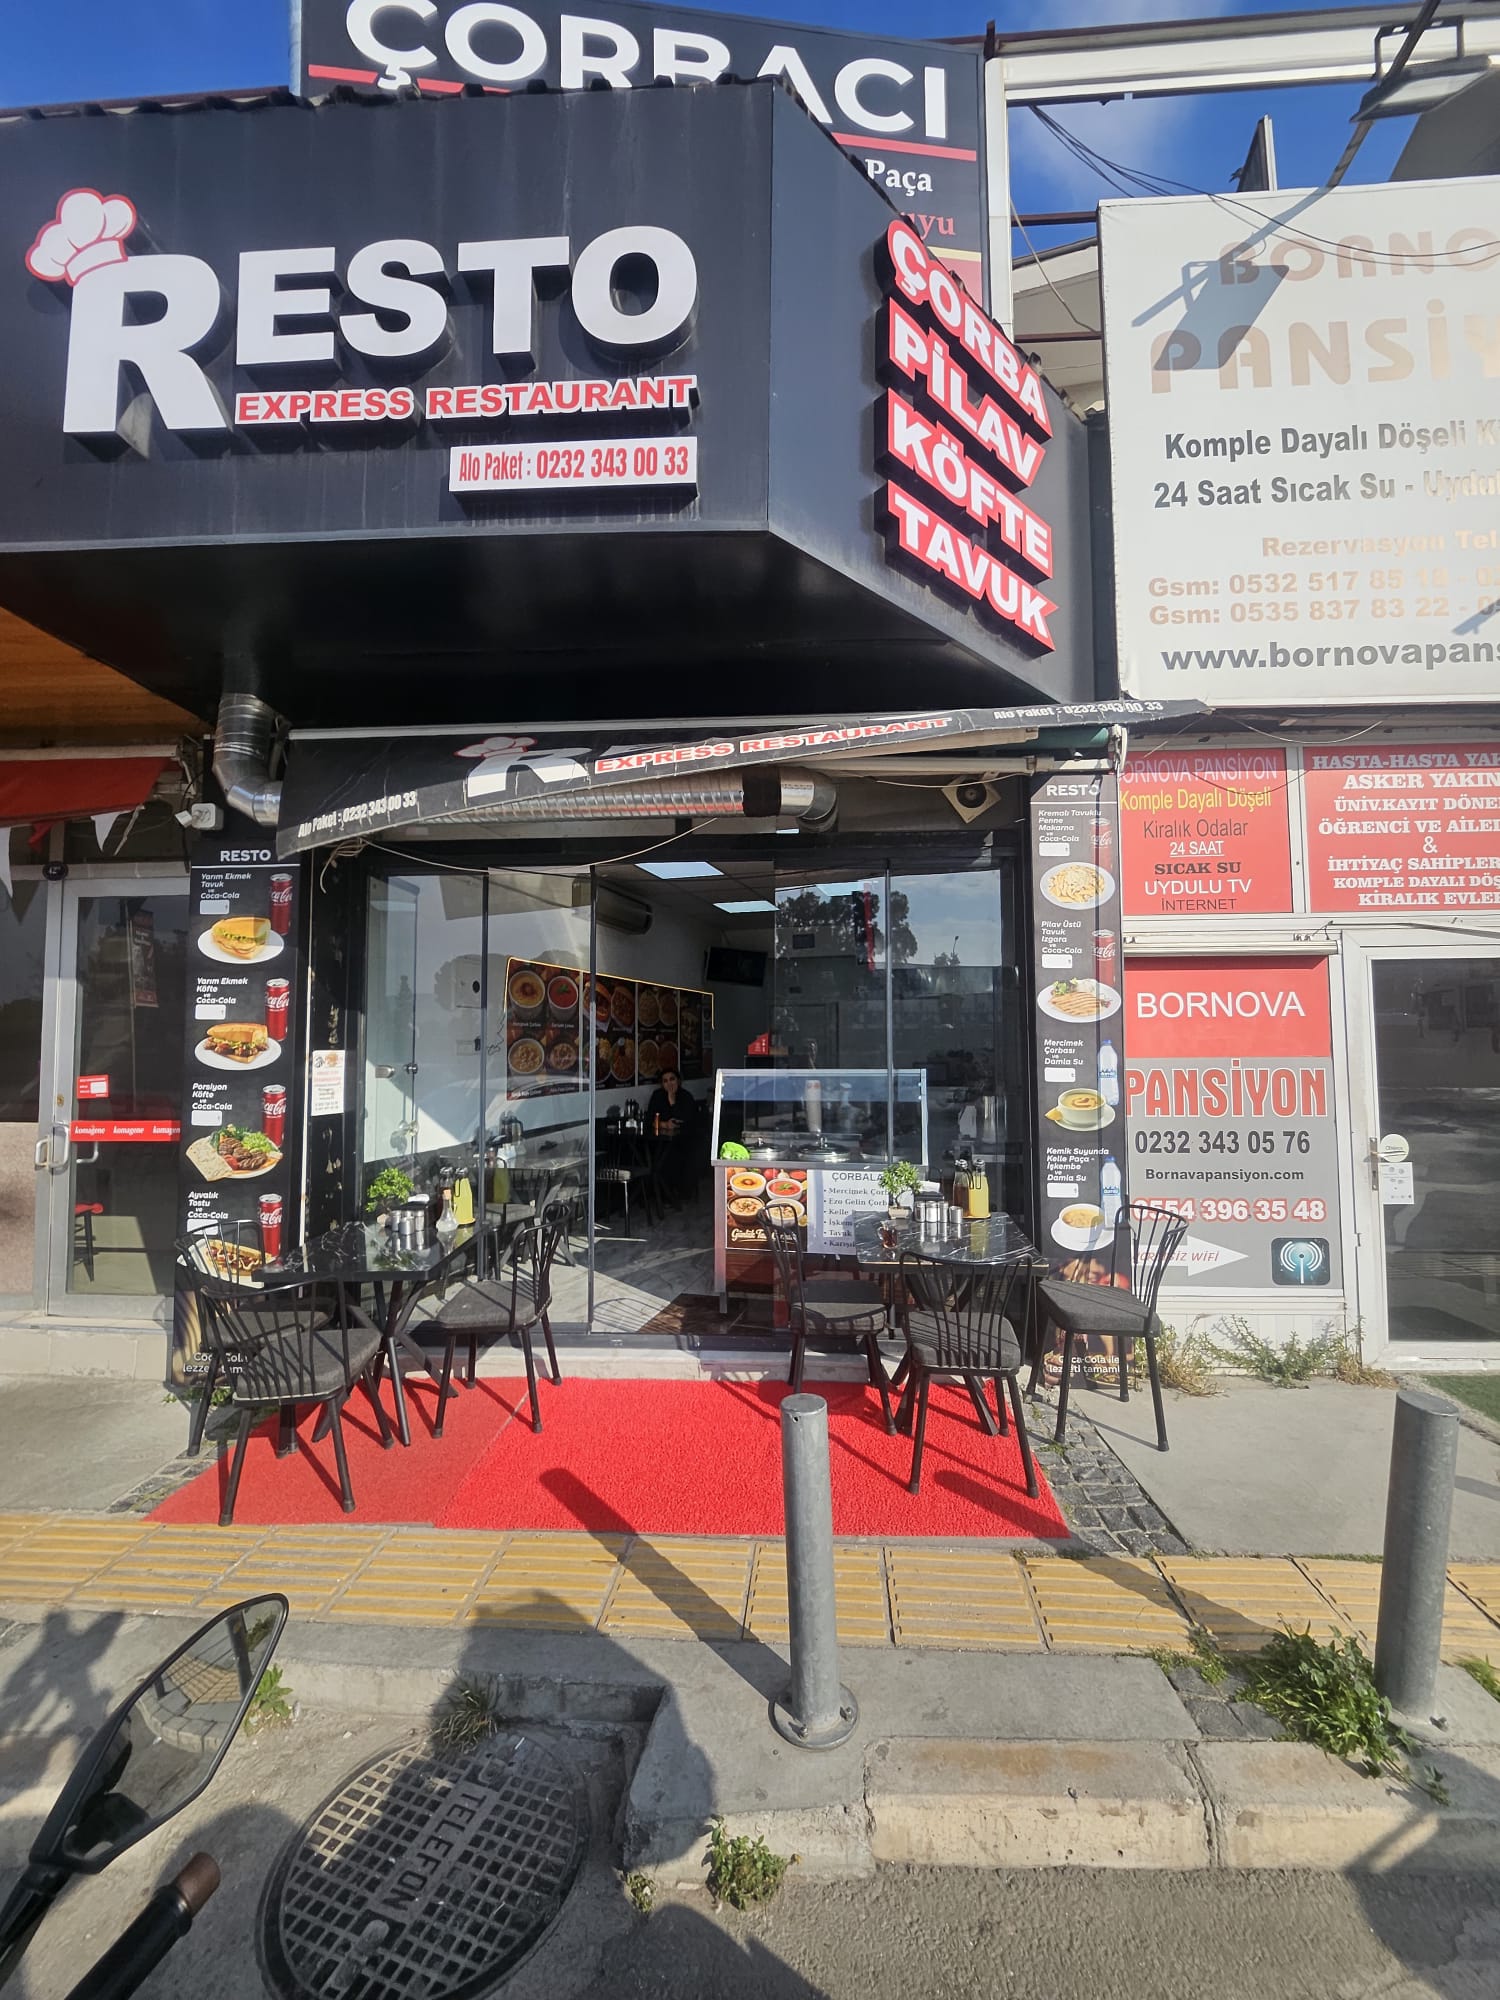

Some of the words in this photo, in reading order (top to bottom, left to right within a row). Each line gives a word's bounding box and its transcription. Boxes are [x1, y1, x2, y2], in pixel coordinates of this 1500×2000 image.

[346, 0, 948, 139] ÇORBACI
[864, 158, 933, 195] Paça
[62, 225, 697, 432] RESTO
[890, 225, 1048, 420] ÇORBA
[236, 388, 413, 424] EXPRESS
[427, 376, 697, 416] RESTAURANT
[892, 321, 1039, 483] PİLAV
[1165, 429, 1271, 462] Komple
[1281, 423, 1368, 459] Dayalı
[1378, 419, 1465, 455] Döşeli
[459, 452, 480, 483] Alo
[483, 451, 523, 482] Paket
[536, 447, 586, 480] 0232
[590, 447, 627, 479] 343
[633, 446, 659, 477] 00
[663, 445, 689, 476] 33
[892, 402, 1050, 568] KÖFTE
[1154, 483, 1188, 508] 24
[1197, 477, 1261, 505] Saat
[1270, 474, 1351, 503] Sıcak
[1360, 472, 1395, 498] Su
[1262, 531, 1445, 557] Rezervasyon
[893, 496, 1052, 639] TAVUK
[1148, 576, 1219, 597] Gsm:
[1229, 571, 1298, 594] 0532
[1307, 570, 1358, 592] 517
[1369, 569, 1405, 590] 85
[1149, 605, 1220, 625] Gsm:
[1230, 601, 1299, 623] 0535
[1308, 600, 1360, 622] 837
[1371, 598, 1405, 620] 83
[1416, 596, 1450, 618] 22
[993, 711, 1015, 720] Alo
[1064, 704, 1097, 714] 0232
[1097, 703, 1124, 713] 343
[1124, 702, 1143, 713] 00
[1146, 701, 1164, 711] 33
[595, 743, 735, 774] EXPRESS
[740, 717, 952, 753] RESTAURANT
[1119, 758, 1193, 784] ORNOVA
[1193, 752, 1278, 782] PANSİYON
[1312, 753, 1460, 770] HASTA-HASTA
[1343, 773, 1425, 790] ASKER
[1046, 784, 1100, 797] RESTO
[1120, 788, 1173, 814] Komple
[1177, 787, 1222, 813] Dayalı
[1227, 786, 1272, 812] Döşeli
[1334, 795, 1439, 812] ÜNİV.KAYIT
[1443, 793, 1500, 810] DÖNE
[298, 821, 312, 838] Alo
[343, 803, 368, 823] 0232
[368, 797, 387, 816] 343
[387, 794, 402, 811] 00
[402, 790, 417, 808] 33
[1038, 817, 1064, 825] Penne
[1038, 824, 1075, 832] Makarna
[1143, 820, 1192, 839] Kiralık
[1196, 818, 1249, 837] Odalar
[1318, 817, 1411, 835] ÖĞRENCİ
[1414, 820, 1442, 833] VE
[1169, 841, 1186, 856] 24
[1188, 840, 1224, 855] SAAT
[1422, 836, 1438, 854] &
[220, 849, 272, 863] RESTO
[1327, 855, 1403, 873] İHTİYAÇ
[224, 872, 252, 880] Ekmek
[1154, 863, 1211, 875] SICAK
[1217, 862, 1241, 873] SU
[200, 881, 225, 889] Tavuk
[1144, 880, 1222, 896] UYDULU
[1226, 878, 1252, 894] TV
[1333, 877, 1404, 889] KOMPLE
[1408, 875, 1466, 888] DAYALI
[200, 892, 241, 900] Coca-Cola
[1161, 897, 1237, 911] İNTERNET
[1358, 889, 1440, 906] KİRALIK
[1041, 920, 1062, 928] Pilav
[1063, 919, 1081, 928] Üstü
[1041, 928, 1066, 936] Tavuk
[196, 985, 218, 993] Köfte
[220, 977, 249, 985] Ekmek
[196, 997, 237, 1005] Coca-Cola
[1136, 990, 1307, 1018] BORNOVA
[1044, 1039, 1084, 1048] Mercimek
[1044, 1057, 1072, 1066] Damla
[1074, 1057, 1084, 1066] Su
[192, 1082, 228, 1093] Porsiyon
[192, 1090, 214, 1099] Köfte
[1126, 1058, 1329, 1118] PANSİYON
[191, 1102, 233, 1111] Coca-Cola
[113, 1125, 145, 1136] komagene
[1134, 1130, 1191, 1154] 0232
[1198, 1130, 1241, 1154] 343
[1247, 1130, 1276, 1154] 05
[1282, 1130, 1312, 1154] 76
[1047, 1147, 1072, 1155] Kemik
[1074, 1148, 1109, 1156] Suyunda
[1047, 1155, 1068, 1163] Kelle
[1069, 1155, 1090, 1164] Paça
[831, 1172, 886, 1182] ÇORBALA
[1047, 1174, 1075, 1182] Damla
[1076, 1174, 1087, 1182] Su
[1145, 1168, 1305, 1182] Bornavapansiyon.com
[187, 1191, 219, 1201] Ayvalık
[870, 1188, 889, 1197] Çorb
[188, 1199, 211, 1208] Tostu
[868, 1199, 889, 1207] Çorb
[1133, 1198, 1196, 1221] 0554
[1201, 1199, 1249, 1221] 396
[1255, 1199, 1287, 1221] 35
[1293, 1199, 1326, 1221] 48
[187, 1211, 229, 1220] Coca-Cola
[828, 1208, 849, 1216] Kelle
[383, 1792, 488, 1912] TELEFON
